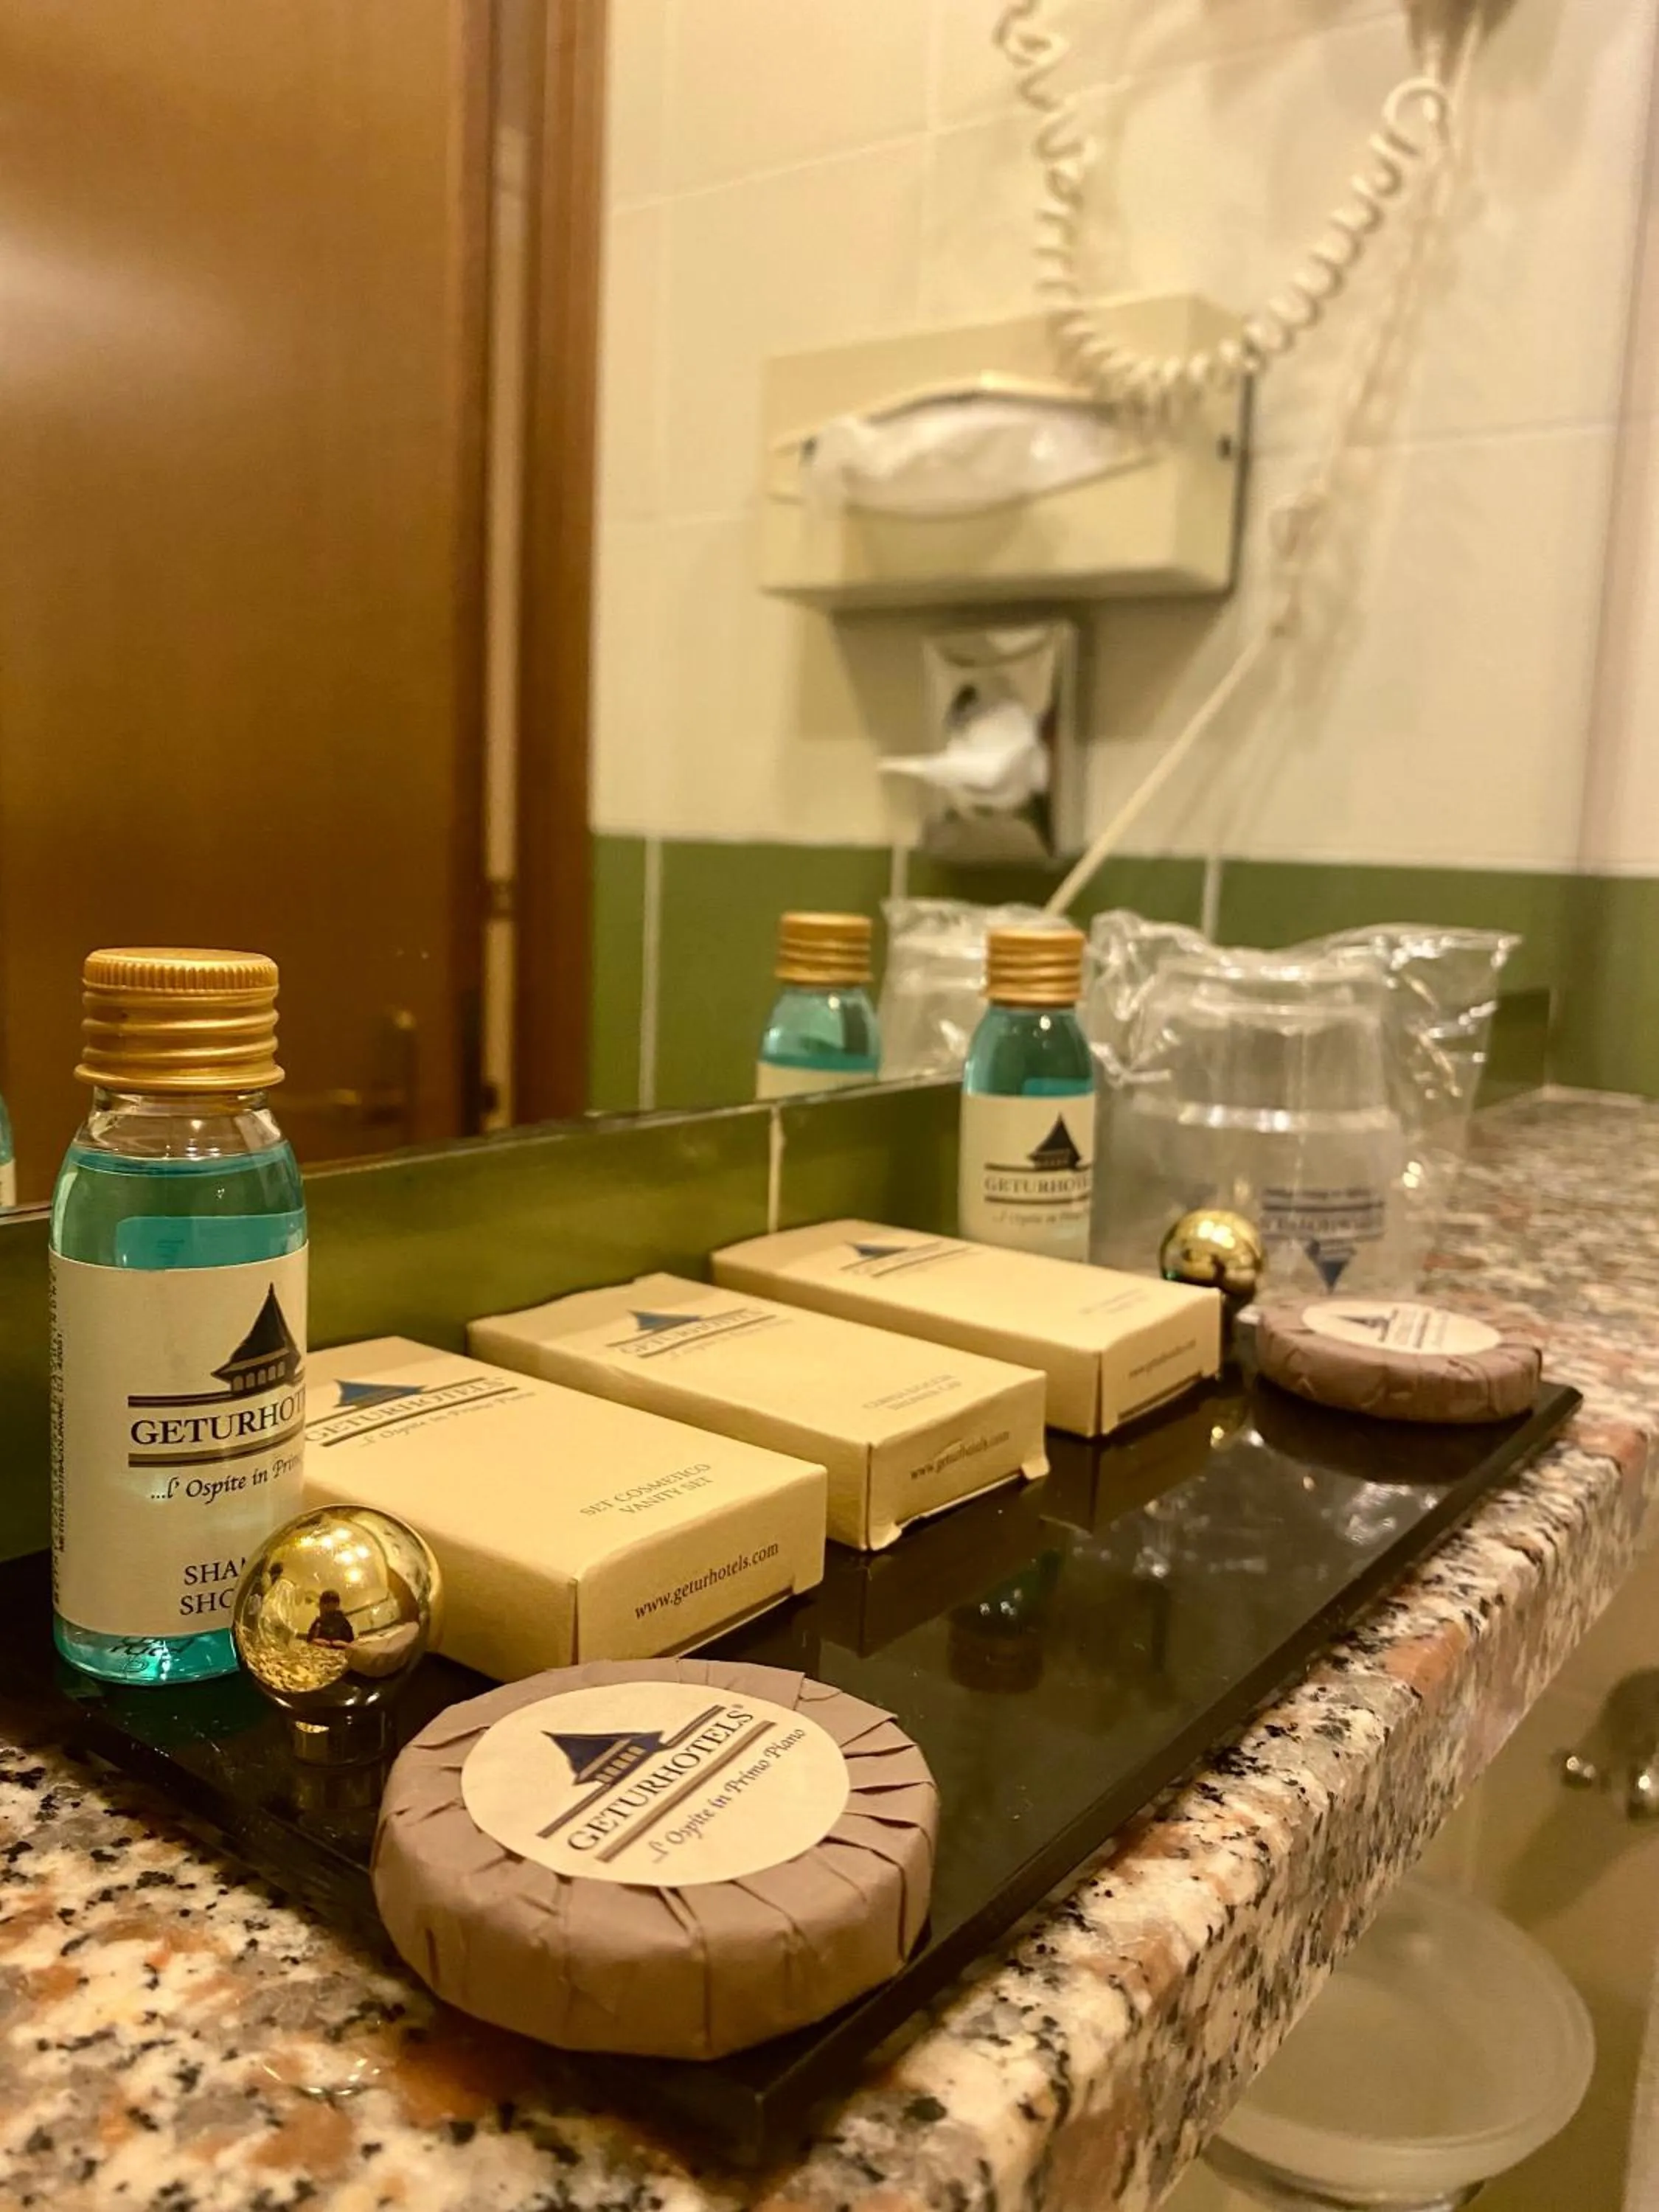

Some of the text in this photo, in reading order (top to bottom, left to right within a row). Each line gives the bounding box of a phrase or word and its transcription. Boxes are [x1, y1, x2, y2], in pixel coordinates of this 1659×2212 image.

[186, 1476, 247, 1505] Ospite
[252, 1468, 268, 1486] in
[580, 1463, 712, 1516] SET COSMETICO
[618, 1475, 714, 1514] VANITY SET
[634, 1543, 780, 1620] www.geturhotels.com
[665, 1809, 717, 1846] Ospite
[709, 1791, 733, 1809] in
[723, 1759, 771, 1794] Primo
[764, 1728, 807, 1759] Piano
